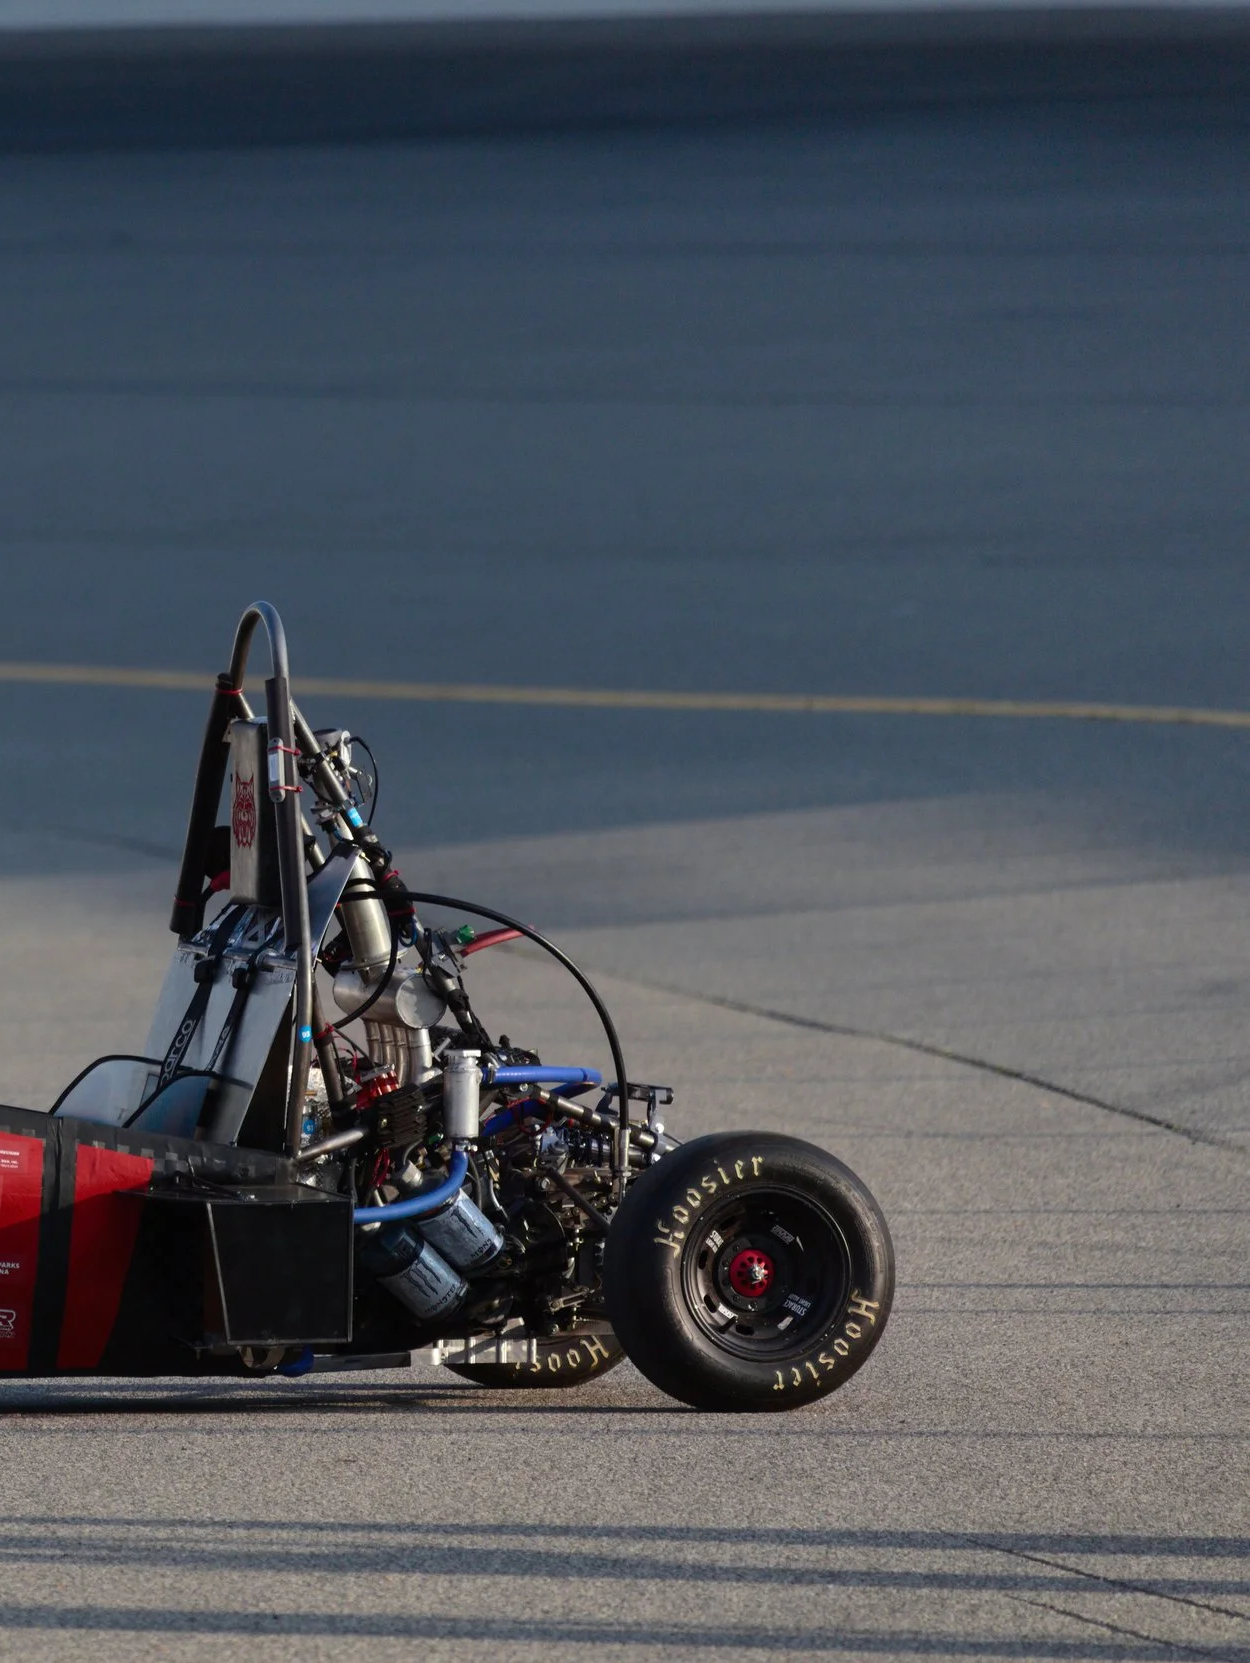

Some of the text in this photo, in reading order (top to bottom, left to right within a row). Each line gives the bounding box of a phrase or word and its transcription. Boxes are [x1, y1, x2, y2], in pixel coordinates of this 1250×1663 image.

[160, 1020, 196, 1087] parco
[654, 1155, 763, 1258] Hoosier
[773, 1288, 879, 1391] Hoosier
